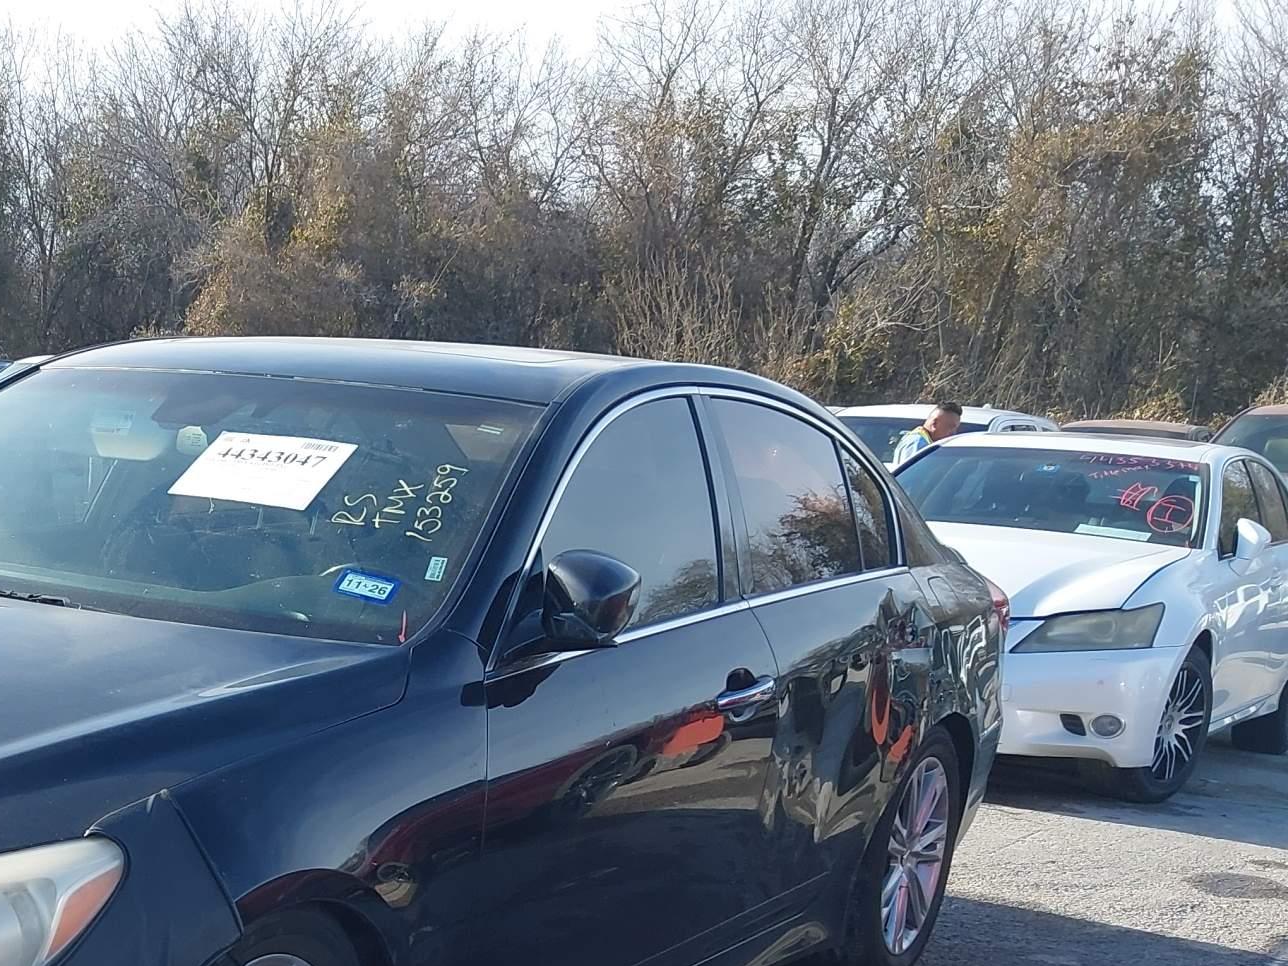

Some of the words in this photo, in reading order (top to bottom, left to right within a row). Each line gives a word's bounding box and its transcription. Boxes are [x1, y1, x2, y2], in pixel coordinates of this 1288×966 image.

[217, 447, 328, 468] 44343047
[330, 493, 378, 526] RS
[405, 463, 470, 542] 153259
